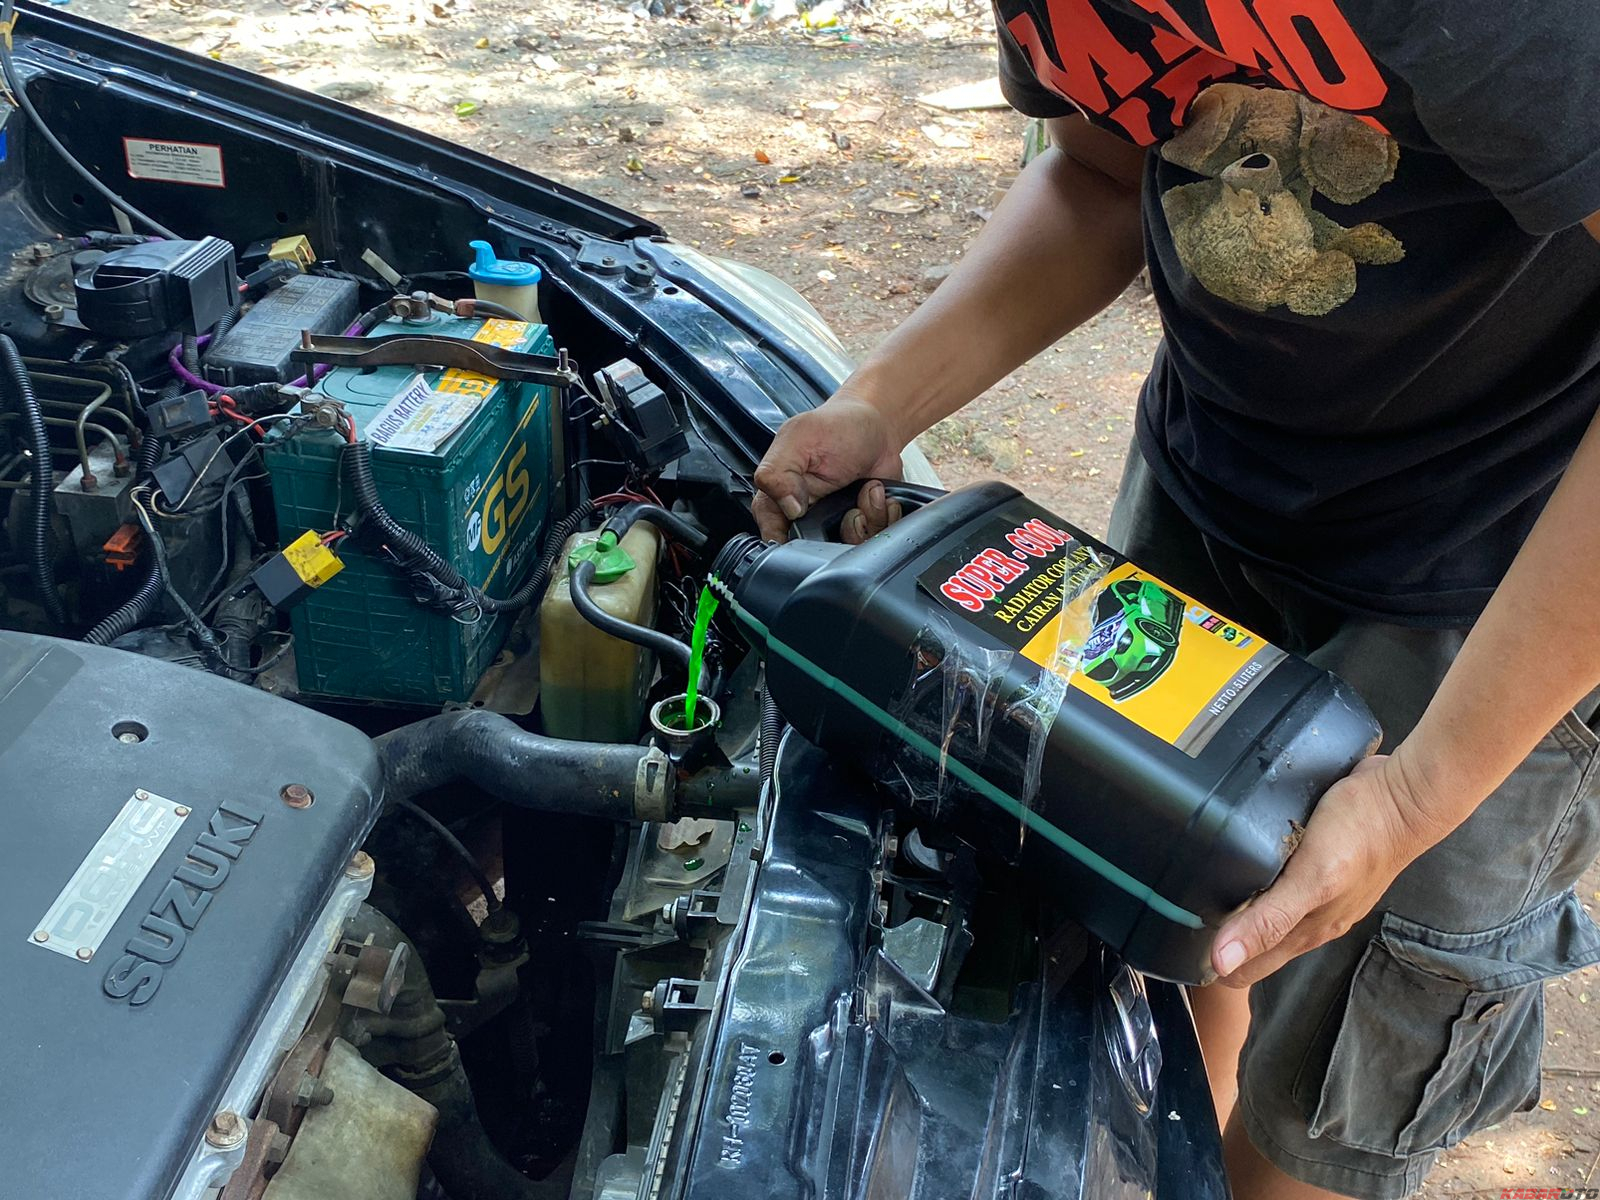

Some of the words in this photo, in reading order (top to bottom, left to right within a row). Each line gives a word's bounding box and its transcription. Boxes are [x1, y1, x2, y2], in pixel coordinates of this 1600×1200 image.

[149, 144, 198, 154] PERHATIAN
[371, 414, 403, 443] BAGUS
[394, 381, 430, 425] BATTERY
[481, 441, 529, 555] GS
[994, 574, 1056, 624] RADIATOR
[1046, 546, 1091, 581] COOLANT
[1016, 592, 1062, 632] CAIRAN
[102, 800, 264, 1006] SUZUKI
